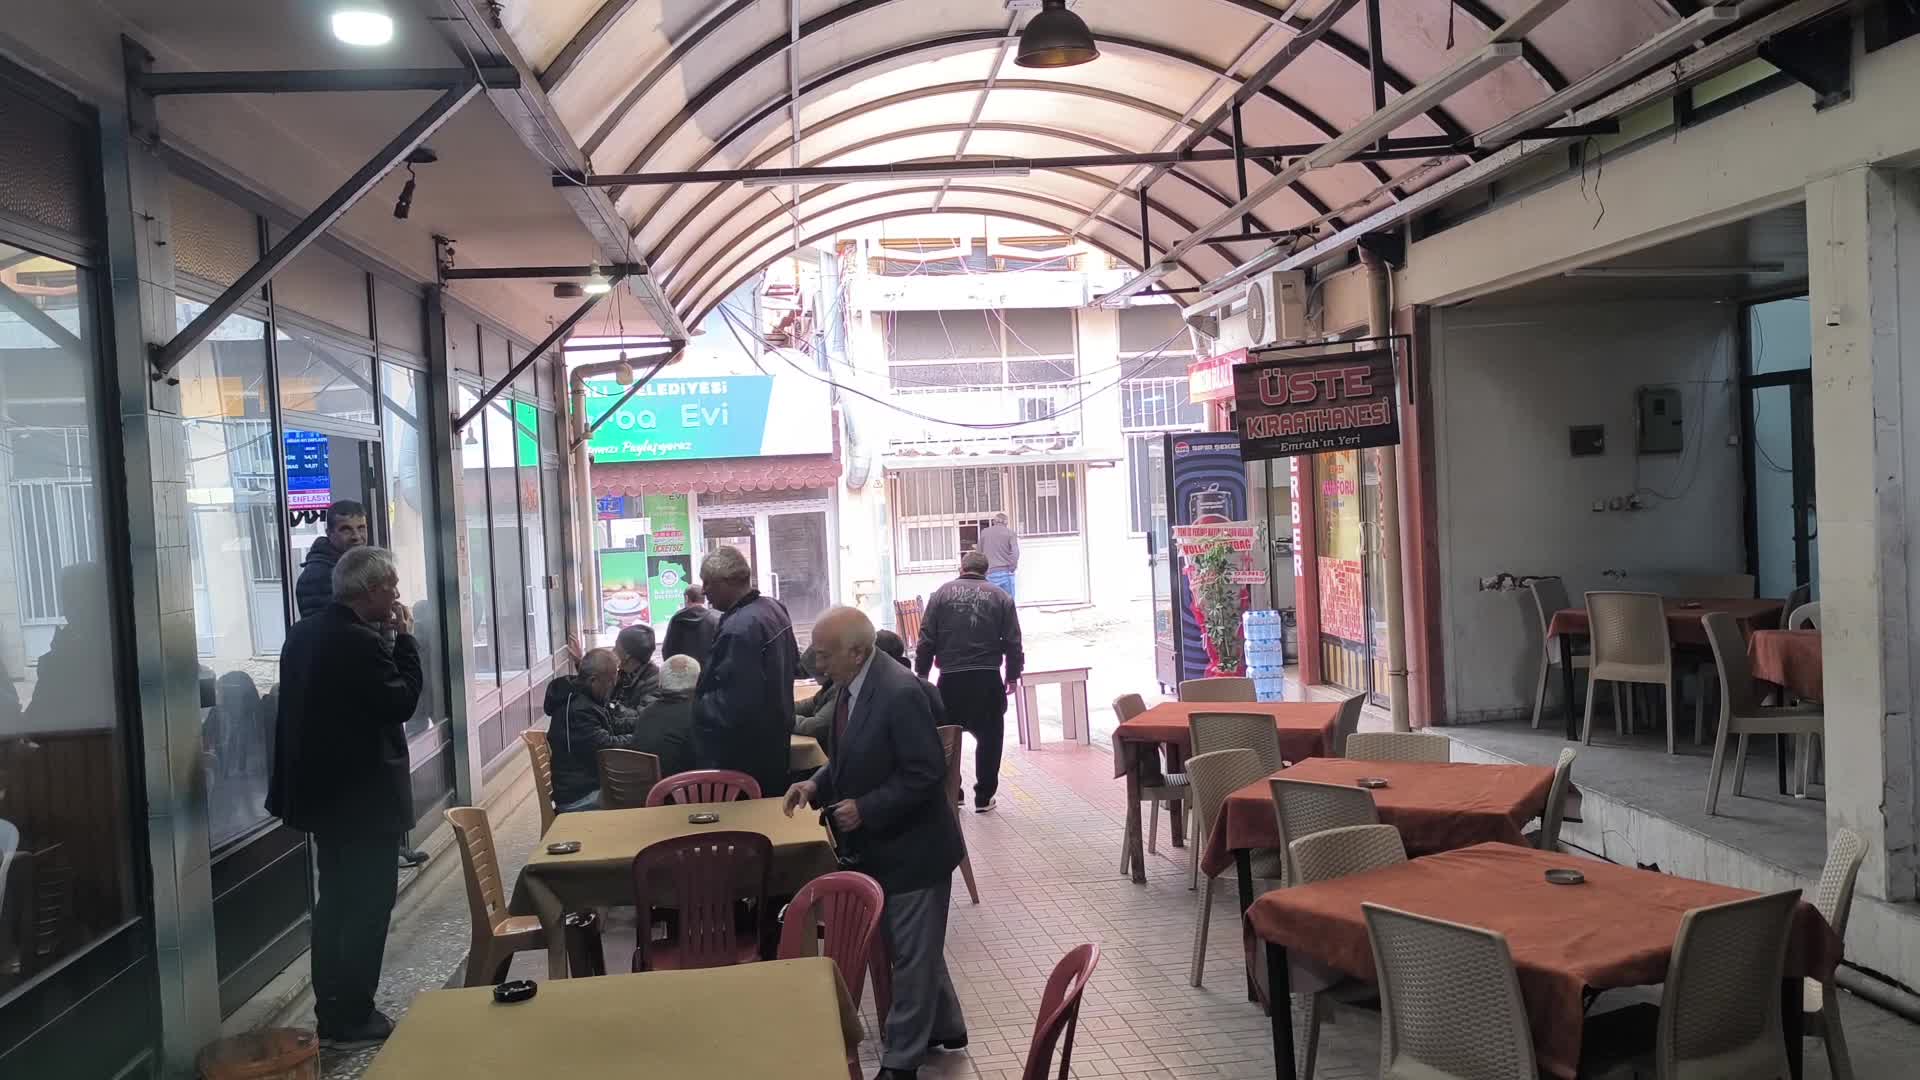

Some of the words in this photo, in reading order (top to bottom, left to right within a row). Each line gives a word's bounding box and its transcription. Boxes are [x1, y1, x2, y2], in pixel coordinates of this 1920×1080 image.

[1259, 366, 1372, 406] ÜSTE
[681, 402, 729, 428] Evi
[1246, 396, 1391, 440] KIRAATHANESİ
[1337, 434, 1361, 446] Yeri
